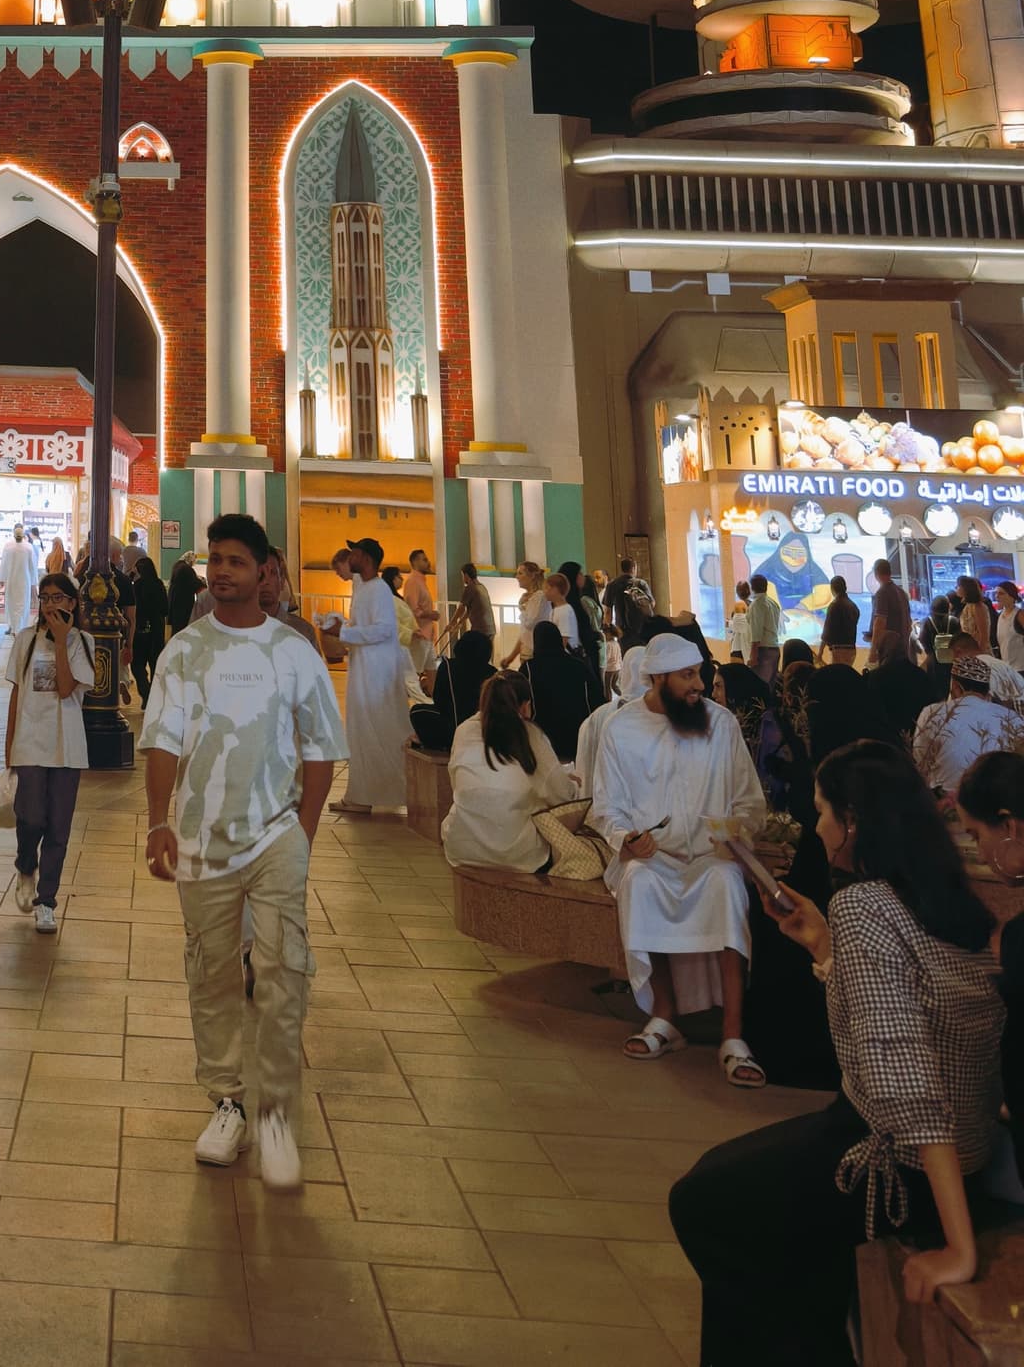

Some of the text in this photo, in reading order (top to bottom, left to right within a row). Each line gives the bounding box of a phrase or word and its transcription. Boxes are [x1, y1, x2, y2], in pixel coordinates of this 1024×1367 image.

[743, 473, 904, 498] EMIRATI FOOD
[219, 672, 264, 682] PREMIUM
